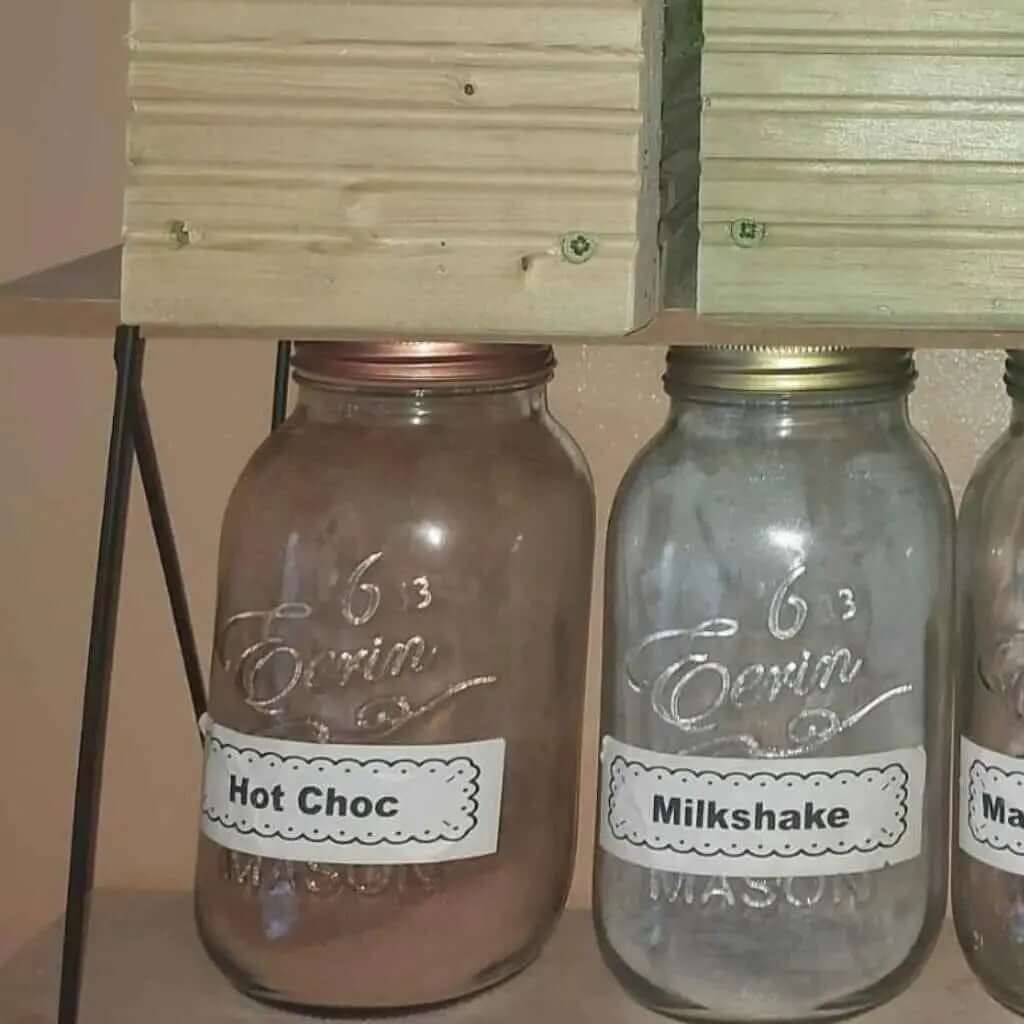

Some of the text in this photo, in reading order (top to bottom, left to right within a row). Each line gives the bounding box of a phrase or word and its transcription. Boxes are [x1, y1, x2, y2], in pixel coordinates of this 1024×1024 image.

[229, 774, 400, 818] Hot Choc
[652, 794, 850, 831] Milkshake
